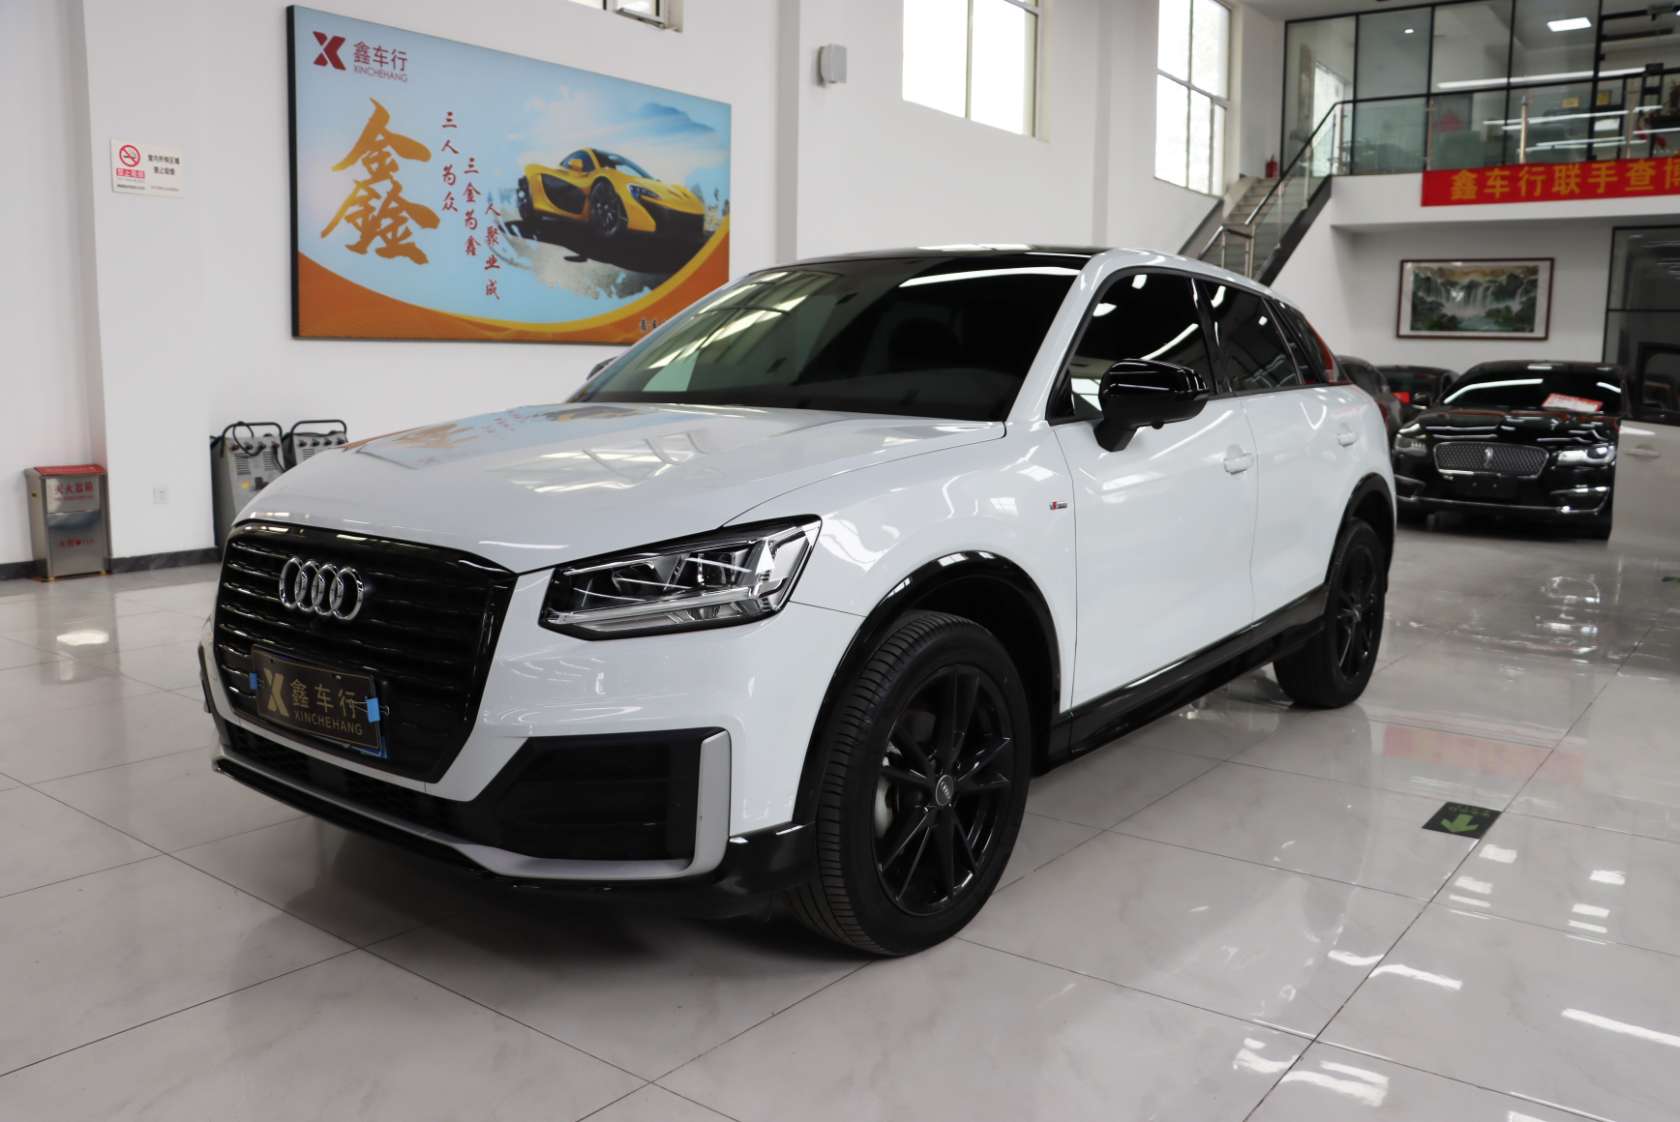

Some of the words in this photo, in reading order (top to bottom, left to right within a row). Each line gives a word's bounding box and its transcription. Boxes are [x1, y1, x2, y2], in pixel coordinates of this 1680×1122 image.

[353, 41, 408, 72] 鑫车行
[354, 64, 408, 82] XINCHEHANG
[321, 97, 440, 265] 鑫
[441, 111, 460, 212] 三人为众
[463, 157, 481, 256] 三金为鑫
[290, 679, 357, 719] 鑫车行
[294, 709, 363, 736] XINCHEHANG
